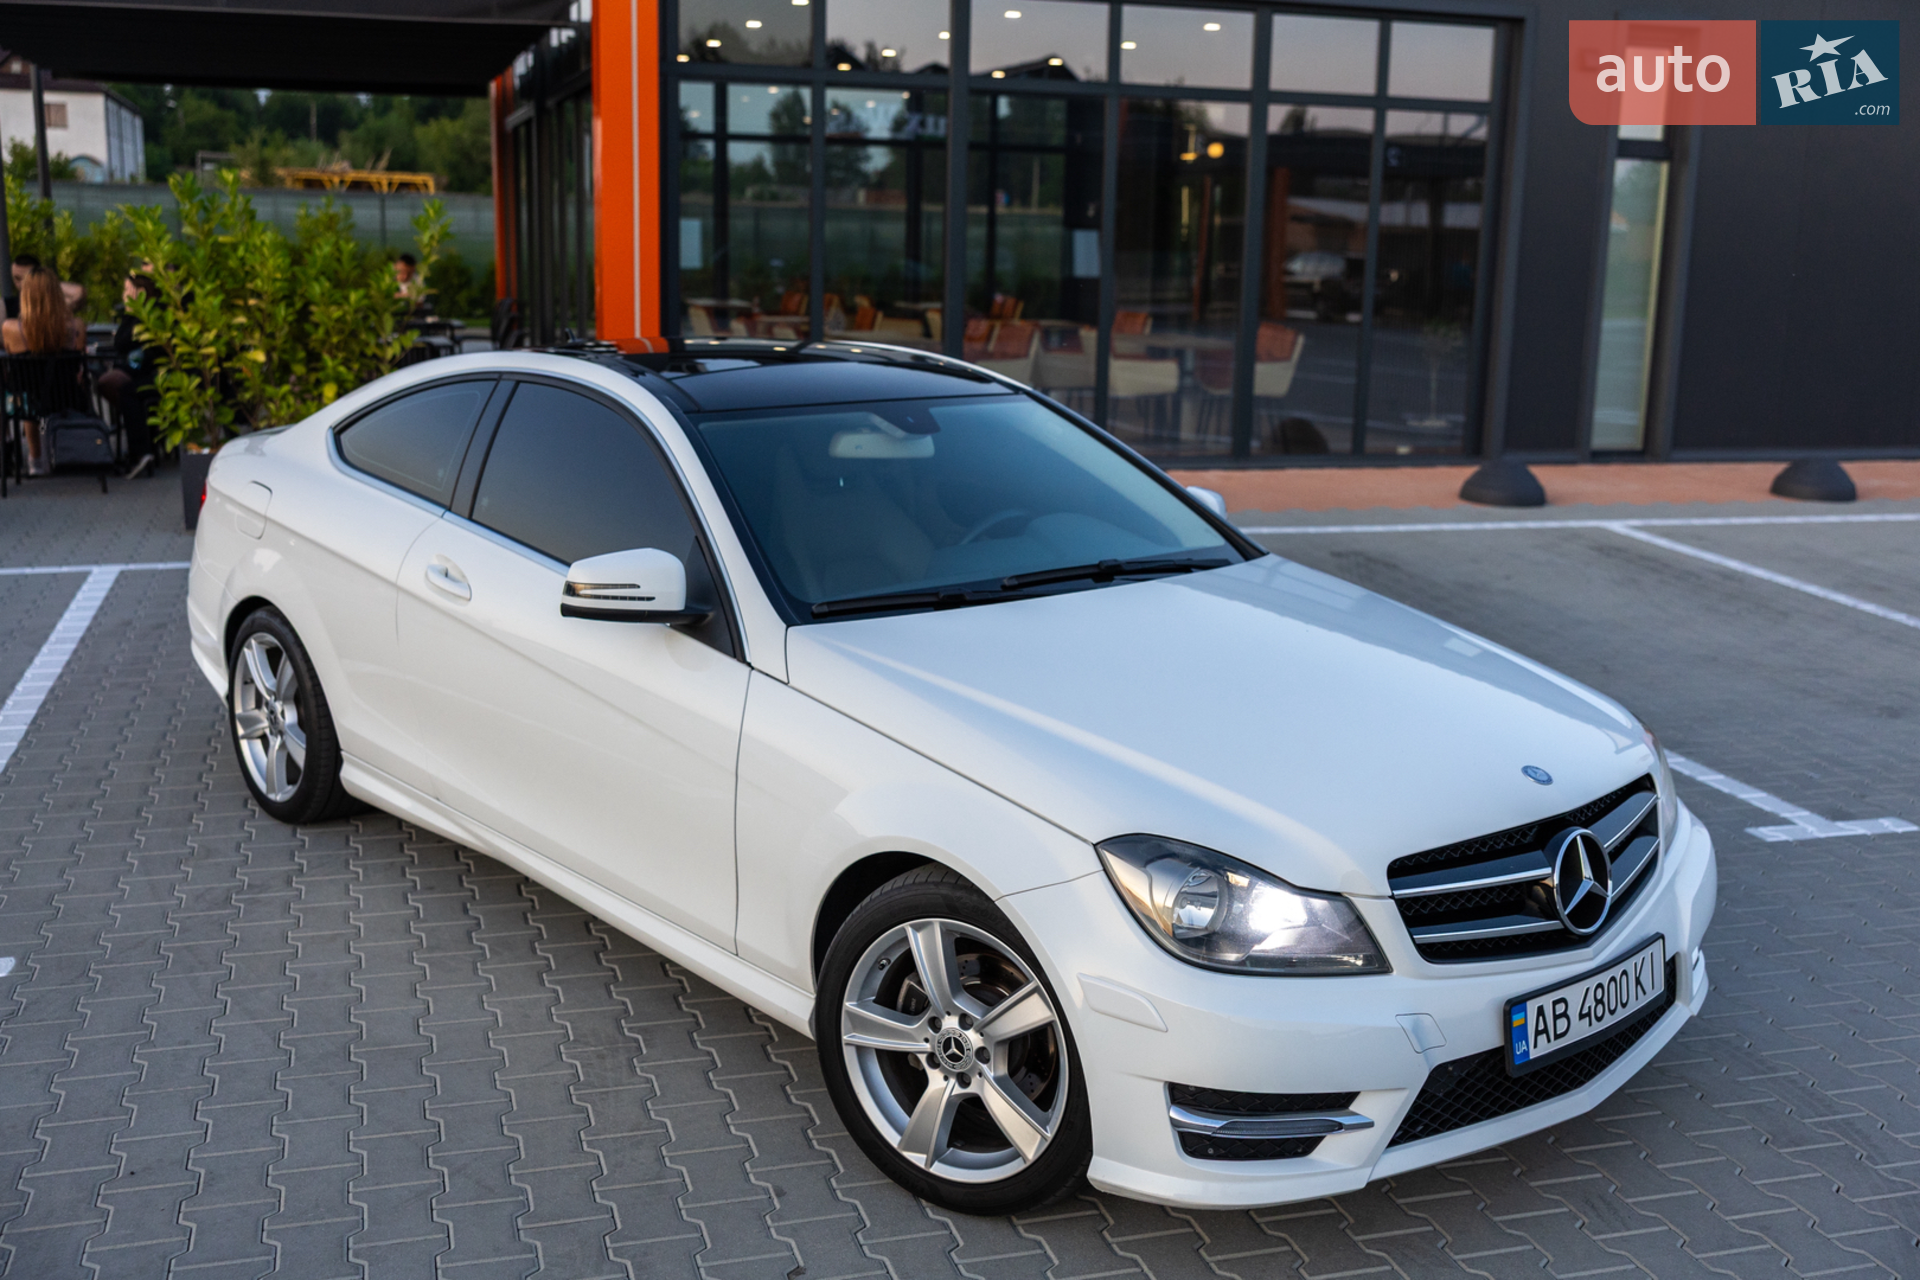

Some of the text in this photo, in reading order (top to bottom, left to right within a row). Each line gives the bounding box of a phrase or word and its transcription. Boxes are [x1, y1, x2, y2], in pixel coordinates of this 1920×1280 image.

[1533, 952, 1655, 1049] AB 4800 KI
[1515, 1039, 1528, 1055] UA
